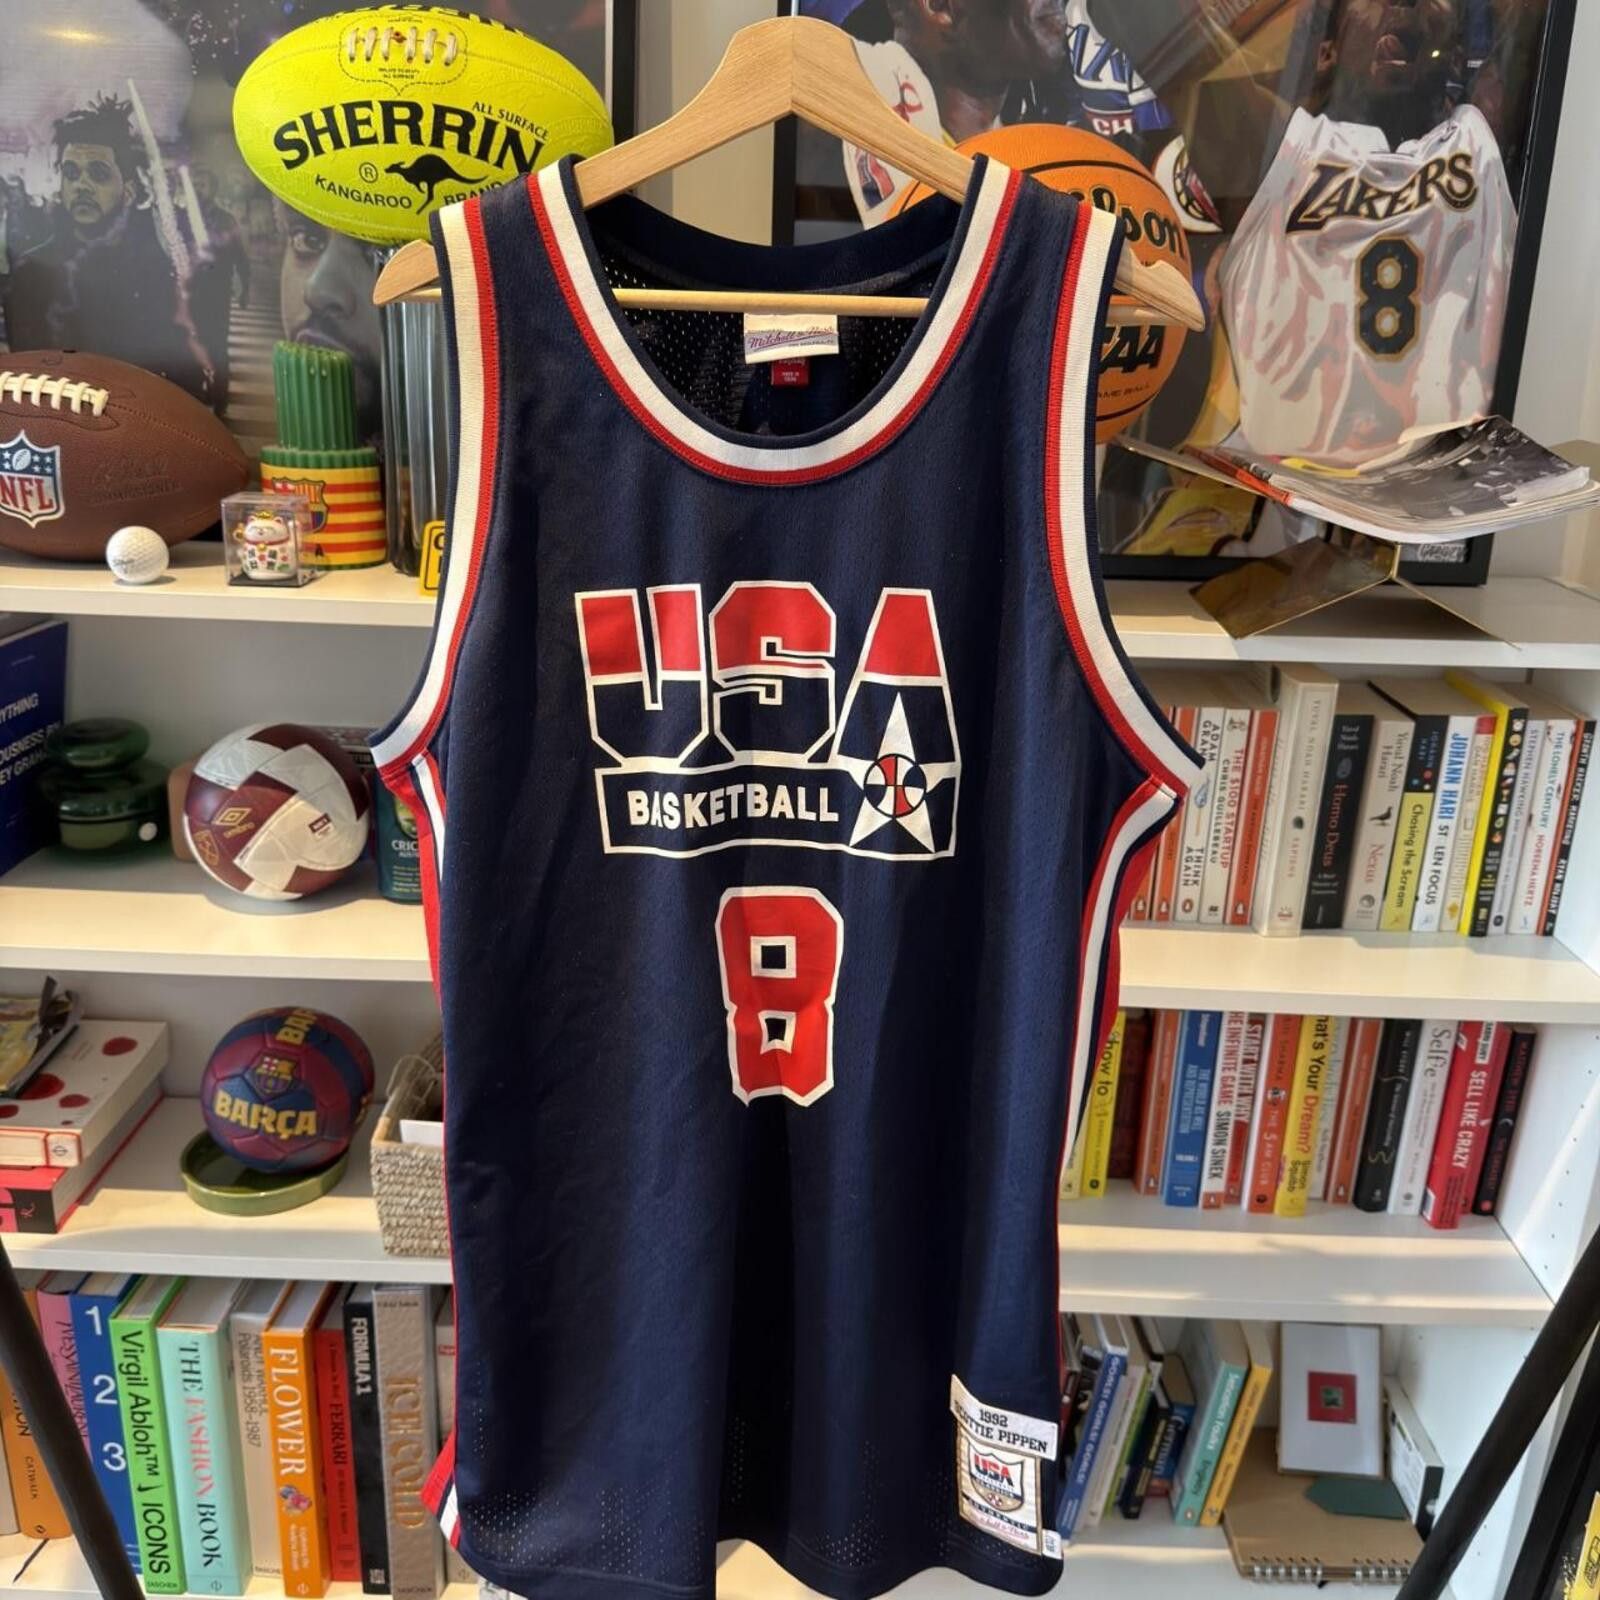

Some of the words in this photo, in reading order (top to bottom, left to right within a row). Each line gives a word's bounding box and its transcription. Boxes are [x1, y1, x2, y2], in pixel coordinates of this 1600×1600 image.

[273, 100, 545, 175] SHERRIN
[472, 101, 496, 115] ALL
[498, 109, 549, 140] SURFACE
[315, 174, 412, 209] KANGAROO
[1287, 153, 1479, 234] LAKERS
[1355, 234, 1421, 360] 8
[1099, 325, 1166, 374] AA
[1097, 387, 1121, 399] AME
[0, 475, 54, 513] NFL
[575, 581, 961, 766] USA
[0, 692, 39, 725] YTHING
[1309, 700, 1321, 733] YUVAL
[1200, 720, 1212, 760] GRAN
[1208, 724, 1220, 762] ADAM
[1304, 737, 1316, 767] NOAH
[1393, 732, 1409, 761] Yuval
[1444, 733, 1468, 784] JOHANN
[1523, 729, 1538, 770] STEPHEN
[1553, 732, 1565, 748] THE
[1579, 733, 1593, 764] GROWTH
[1218, 759, 1230, 792] CHRIS
[1232, 748, 1244, 772] THE
[1377, 745, 1393, 779] Harari
[1388, 764, 1403, 792] Noah
[1546, 750, 1561, 785] LONELY
[626, 782, 840, 830] BASKETBALL
[1227, 778, 1240, 808] $100
[1328, 784, 1350, 829] Homo
[1438, 790, 1458, 820] HARI
[1515, 772, 1530, 817] HAWKING
[1539, 787, 1554, 829] CENTURY
[1210, 796, 1225, 864] GUILLEBEAU
[1220, 812, 1235, 869] STARTUP
[1404, 804, 1424, 847] Chasing
[1562, 805, 1578, 845] MARKETING
[1182, 847, 1193, 887] AGAIN
[1192, 847, 1203, 887] THINK
[1322, 832, 1339, 867] Deus
[1365, 843, 1384, 883] Nexus
[1404, 850, 1416, 866] the
[1529, 835, 1545, 876] NOREENA
[1424, 869, 1442, 905] FOCUS
[1556, 859, 1567, 879] RYAN
[1395, 869, 1412, 908] Scream
[1523, 878, 1537, 907] HERTZ
[1547, 883, 1563, 914] HOLIDAY
[714, 886, 846, 1107] 8
[1230, 1012, 1245, 1025] HE
[1312, 1016, 1329, 1050] hat's
[1100, 1040, 1119, 1076] how
[1221, 1027, 1242, 1074] INFINITE
[1242, 1024, 1262, 1061] START
[1275, 1039, 1289, 1080] SHARMA
[1424, 1028, 1451, 1077] Selfie
[1097, 1081, 1112, 1096] to
[1218, 1076, 1235, 1105] GAME
[1238, 1064, 1256, 1094] WITH
[1306, 1054, 1325, 1090] Your
[1468, 1071, 1487, 1098] SELL
[214, 1089, 317, 1139] BARÇA
[1214, 1110, 1231, 1146] SIMON
[1235, 1096, 1251, 1124] WHY
[1296, 1095, 1319, 1153] Dream?
[1460, 1101, 1479, 1127] LIKE
[1209, 1149, 1226, 1180] SINEK
[1452, 1131, 1473, 1168] CRAZY
[1287, 1160, 1301, 1193] Squibb
[1299, 1160, 1311, 1190] Simon
[85, 1306, 102, 1335] 1
[178, 1341, 203, 1392] THE
[237, 1333, 254, 1383] Polaroids
[352, 1317, 370, 1384] FORMULA
[93, 1375, 117, 1404] 2
[356, 1384, 372, 1395] 1
[384, 1376, 424, 1435] ICE
[269, 1348, 306, 1476] FLOWER
[955, 1399, 994, 1439] COTTIE
[998, 1429, 1048, 1453] PIPPEN
[979, 1409, 1008, 1427] 1992
[118, 1330, 149, 1387] Virgil
[142, 1502, 171, 1575] ICONS
[184, 1397, 216, 1498] FASHION
[329, 1403, 347, 1465] FERRARI
[103, 1442, 126, 1471] 3
[974, 1453, 1013, 1487] USA
[390, 1439, 426, 1529] COLD
[196, 1502, 222, 1568] BOOK
